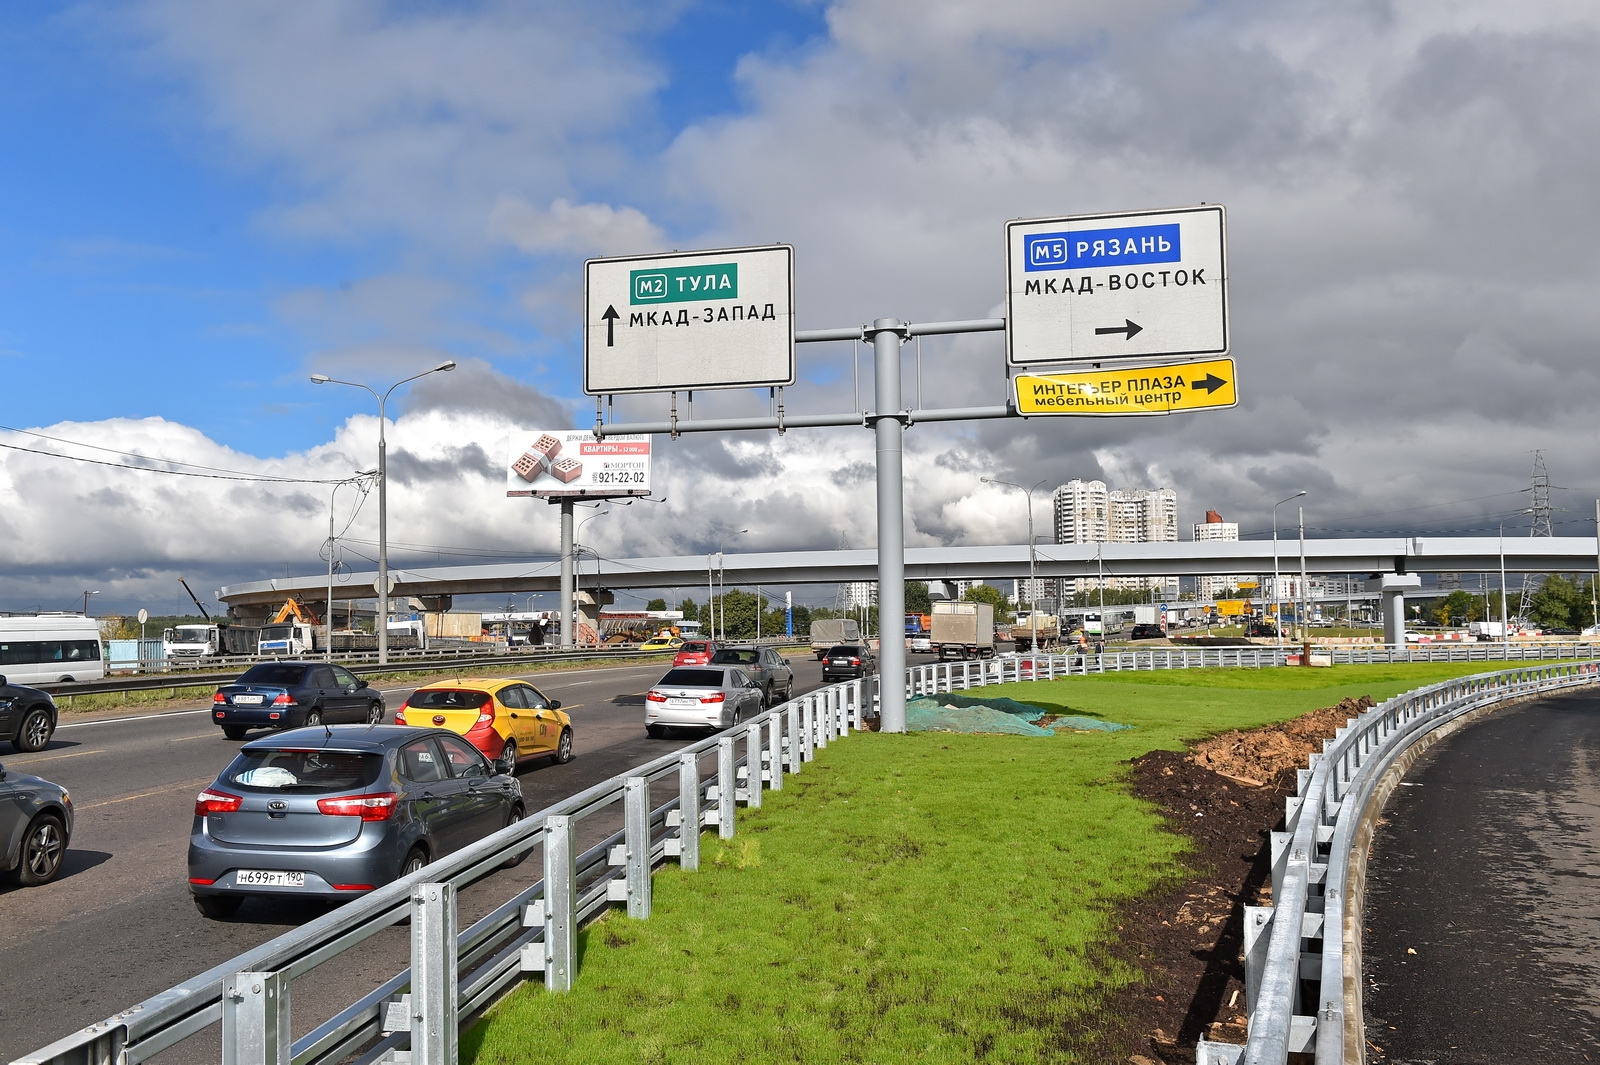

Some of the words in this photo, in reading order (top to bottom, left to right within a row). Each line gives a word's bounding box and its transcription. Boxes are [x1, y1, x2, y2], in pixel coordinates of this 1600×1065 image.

[1035, 244, 1063, 260] М5
[1076, 235, 1172, 258] РЯЗАНЬ
[640, 279, 663, 294] М2
[675, 273, 732, 293] ТУЛА
[1024, 268, 1207, 296] МКАД-ВОСТОК
[629, 303, 776, 328] МКАД-ЗАПАД
[1033, 380, 1122, 396] ИНТЕРЬЕР
[1127, 375, 1186, 392] ПЛАЗА
[1035, 393, 1129, 406] мебельный
[1134, 391, 1182, 406] центр
[583, 445, 619, 453] КВАРТИРЫ
[598, 471, 645, 483] 921-22-02
[271, 801, 287, 809] KIA
[240, 871, 283, 884] Н699РТ
[286, 872, 302, 882] 190
